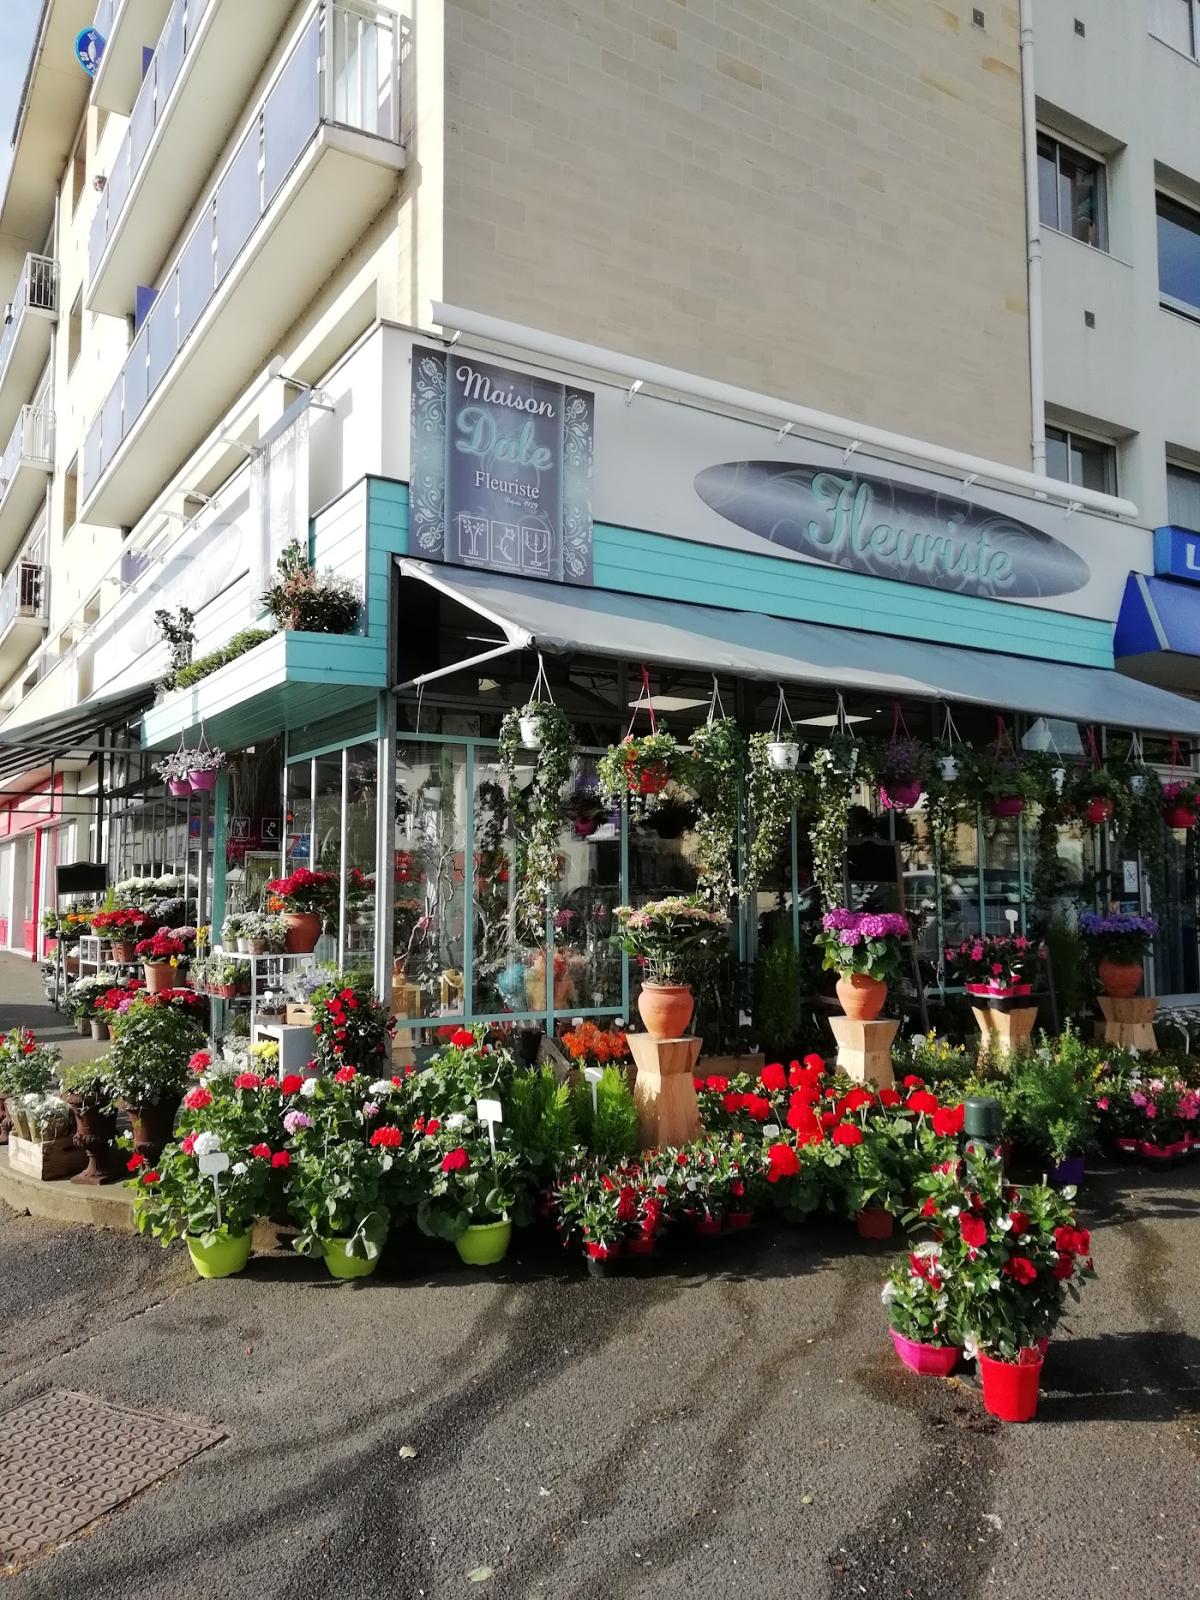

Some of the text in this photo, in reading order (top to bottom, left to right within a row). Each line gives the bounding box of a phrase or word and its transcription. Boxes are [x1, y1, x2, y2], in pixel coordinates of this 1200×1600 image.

[456, 365, 555, 418] Maison
[475, 471, 541, 499] Fleuriste
[807, 472, 1016, 584] Fleuriste
